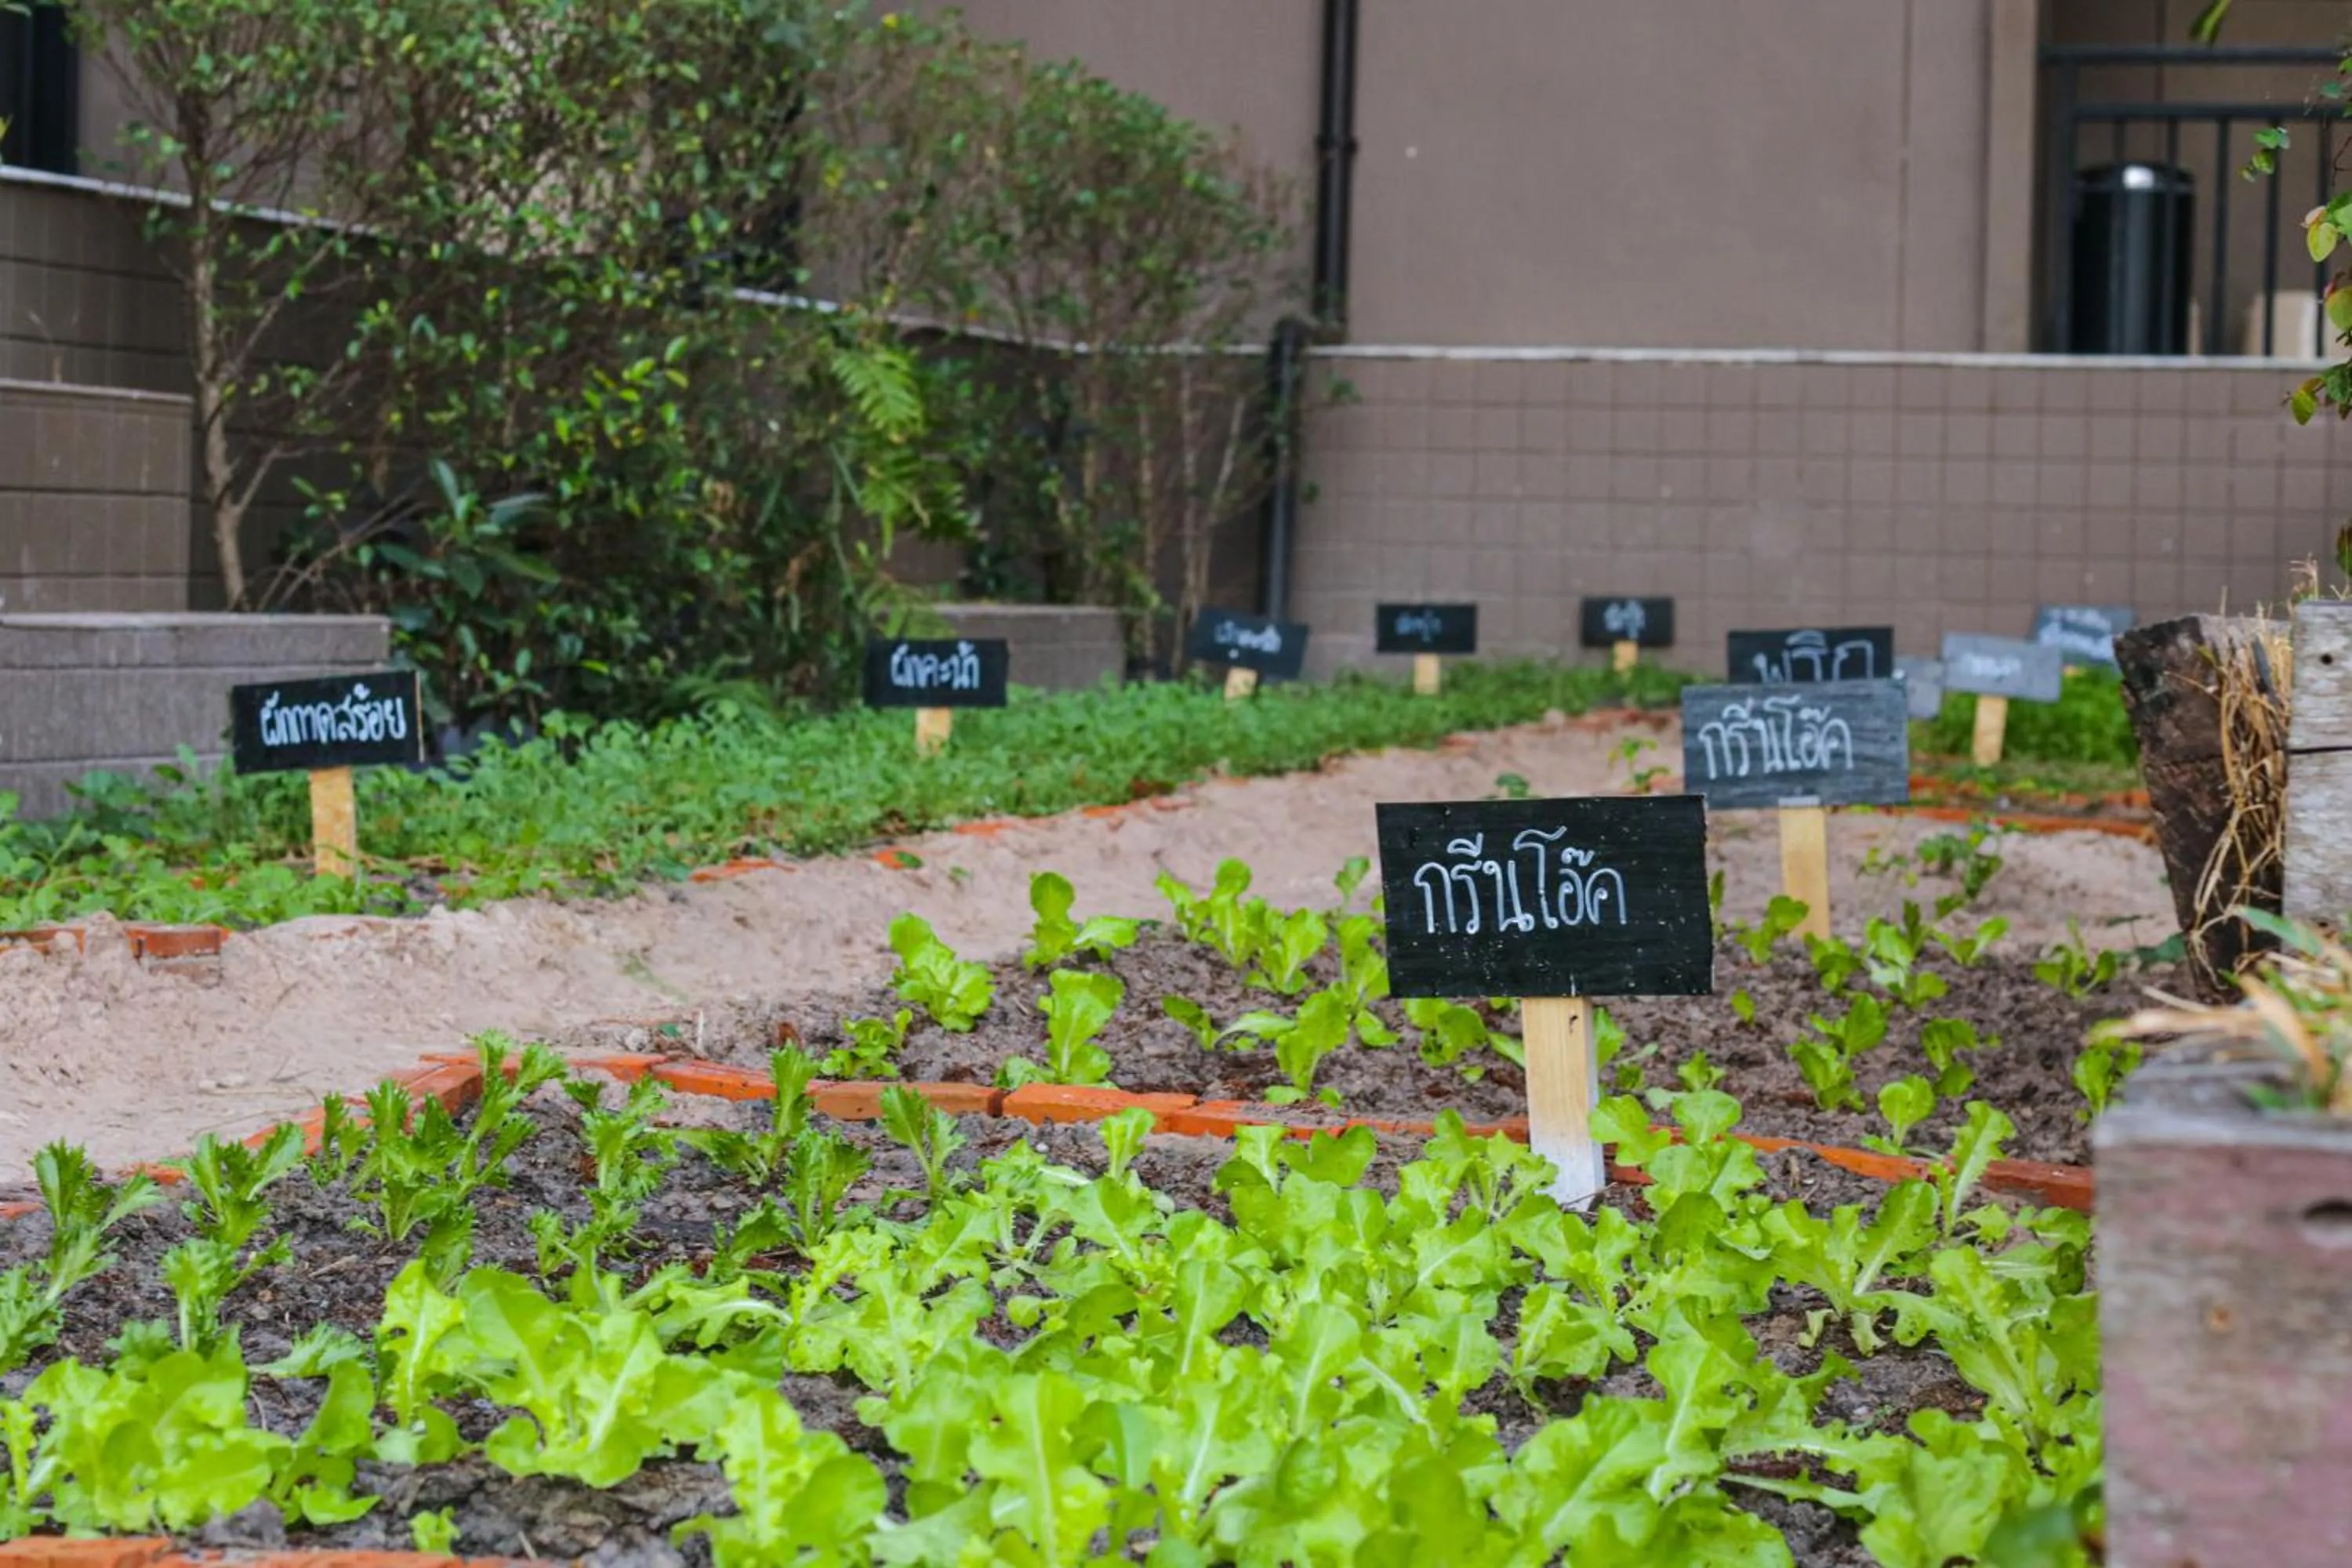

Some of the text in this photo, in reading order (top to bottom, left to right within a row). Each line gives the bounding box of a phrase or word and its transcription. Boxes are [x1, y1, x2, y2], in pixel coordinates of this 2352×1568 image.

[1698, 693, 1854, 780] กรีนโอ๊ค
[1414, 826, 1628, 935] กรีนโอ๊ค
